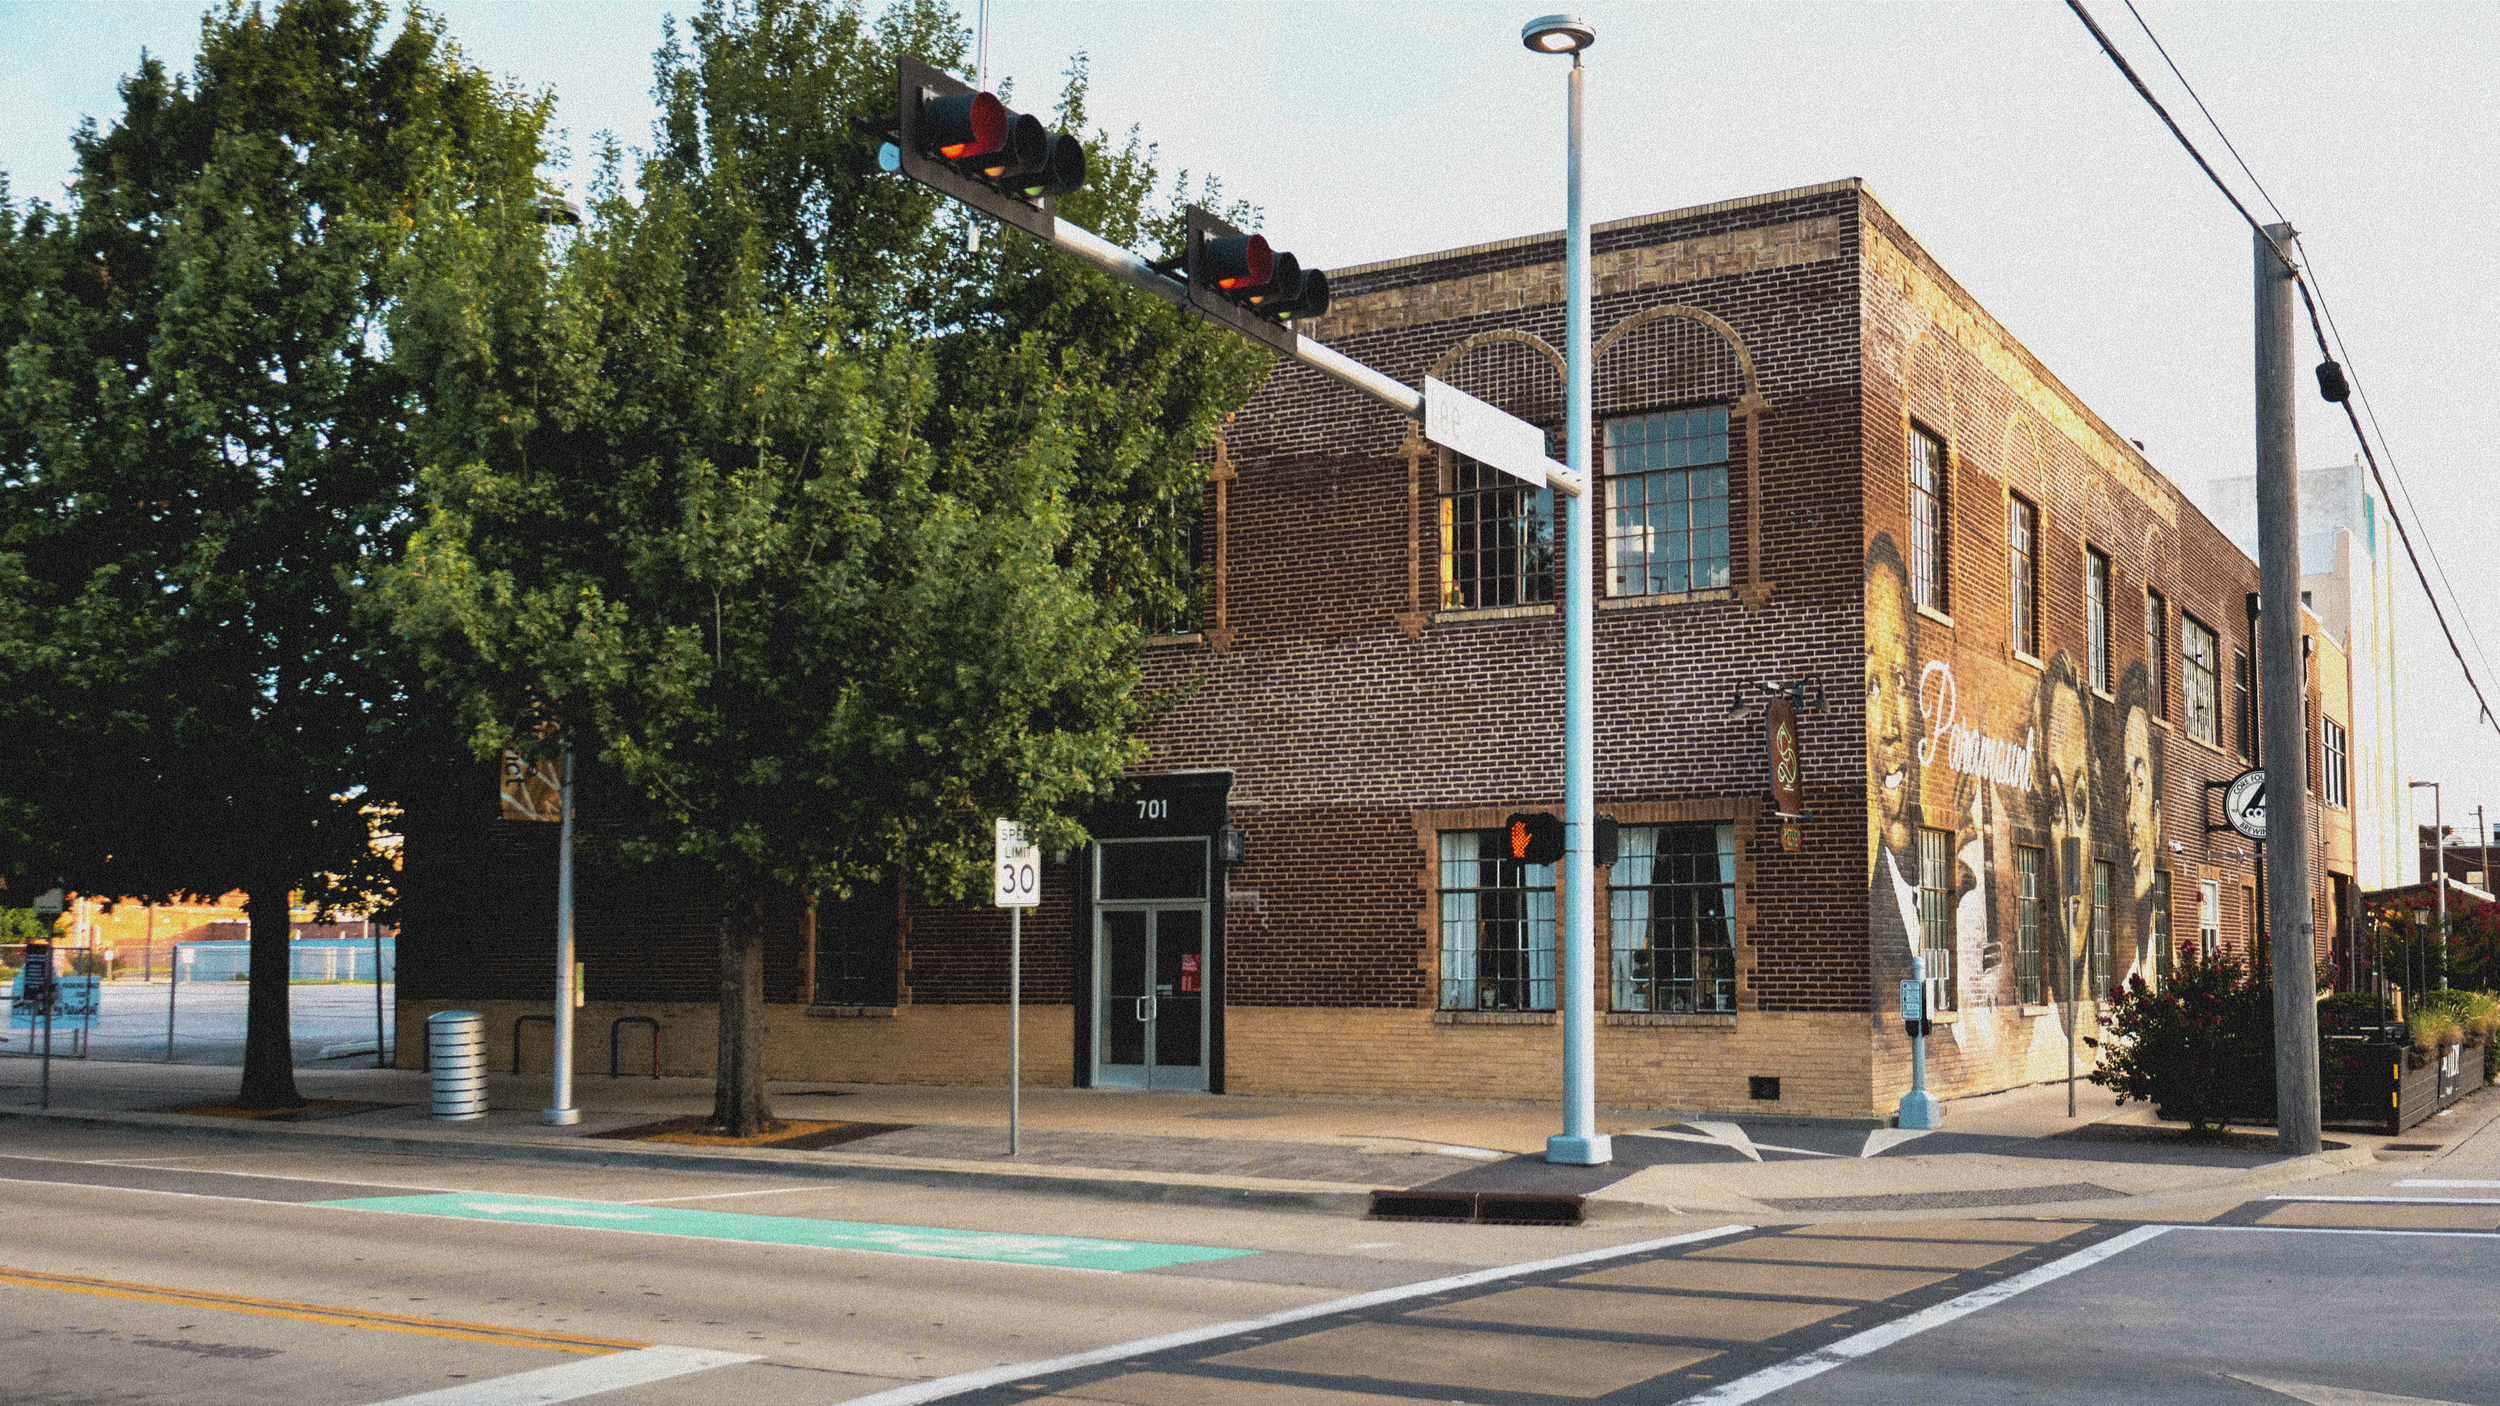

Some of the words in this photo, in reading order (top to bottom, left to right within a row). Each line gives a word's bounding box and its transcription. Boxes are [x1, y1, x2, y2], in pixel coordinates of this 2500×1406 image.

[1430, 387, 1461, 440] Lee
[1918, 660, 2034, 793] Paramount
[2233, 779, 2249, 795] CORE
[1136, 800, 1167, 819] 701
[1002, 827, 1028, 842] SPEE
[1005, 847, 1031, 859] LIMIT
[1002, 864, 1035, 894] 30
